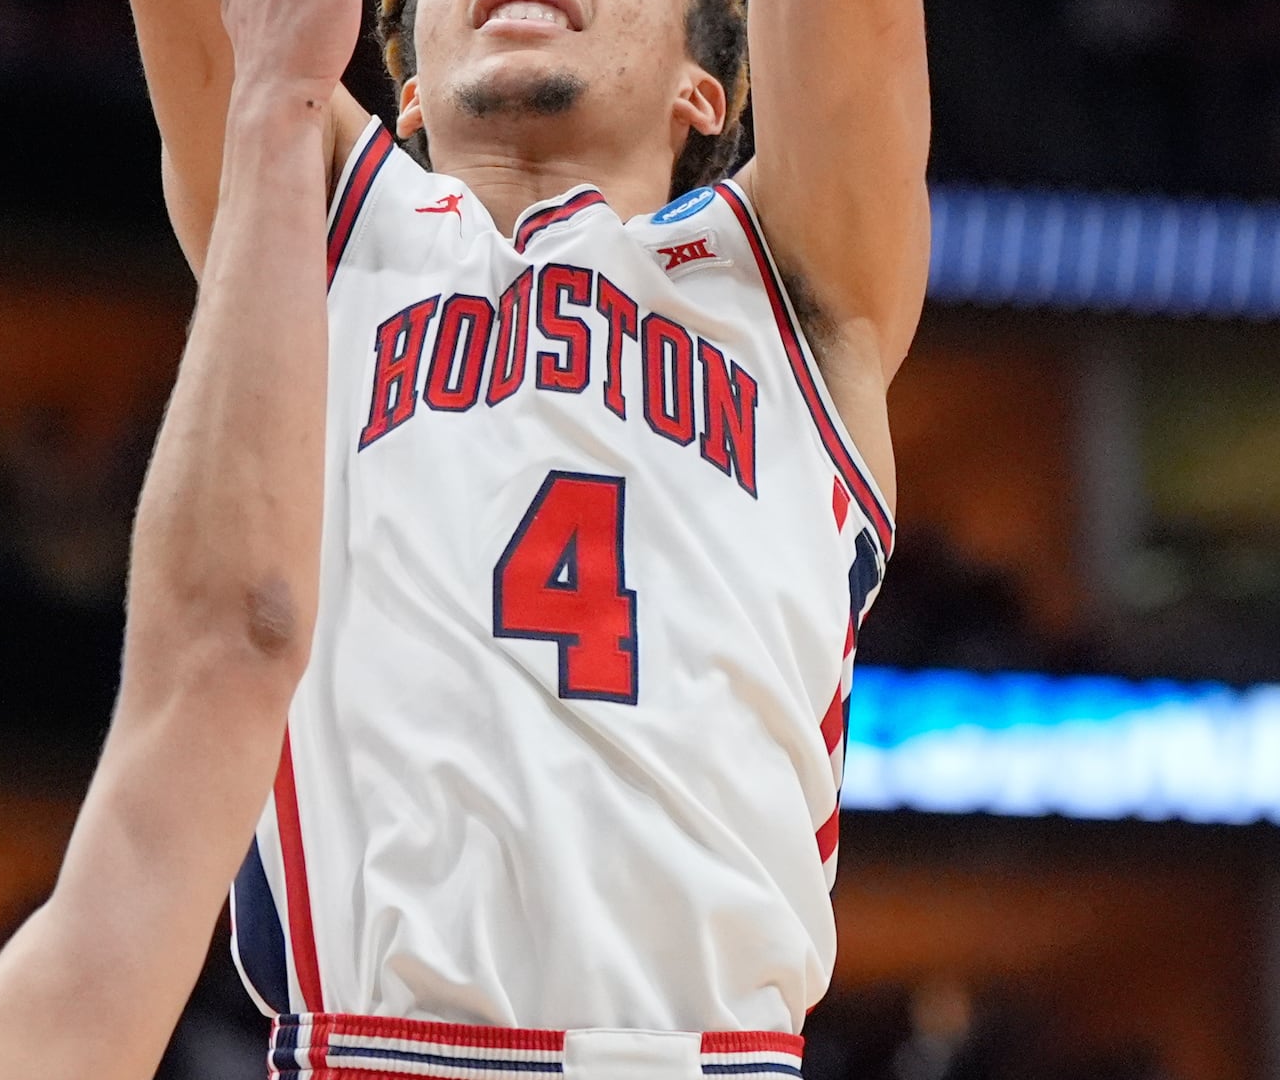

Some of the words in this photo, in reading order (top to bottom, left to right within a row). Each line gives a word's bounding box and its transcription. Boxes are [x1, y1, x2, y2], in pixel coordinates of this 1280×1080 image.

[657, 239, 717, 270] XII
[662, 190, 712, 221] NCAA
[358, 263, 758, 500] HOUSTON
[493, 470, 638, 706] 4
